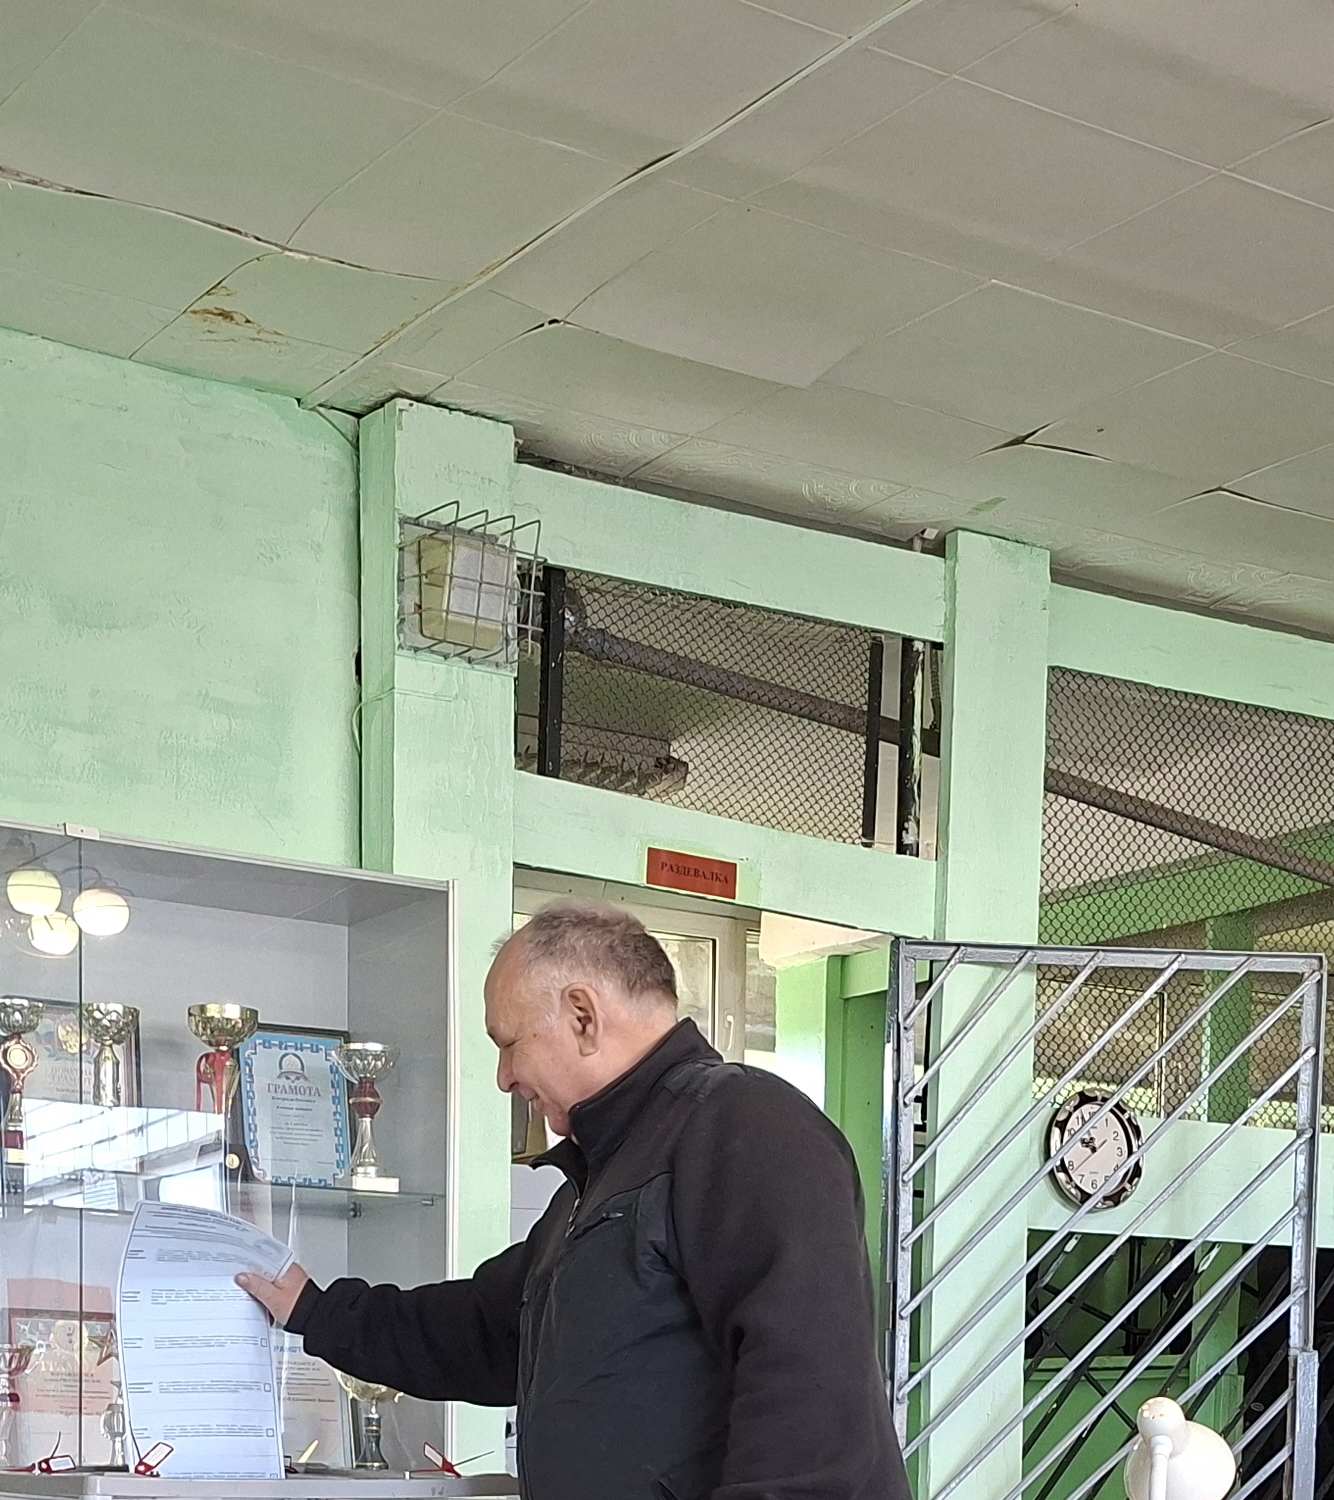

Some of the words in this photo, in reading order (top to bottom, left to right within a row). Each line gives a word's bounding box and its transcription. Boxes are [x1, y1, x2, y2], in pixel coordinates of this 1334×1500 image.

[660, 861, 729, 884] РАЗДЕВАЛКА
[267, 1083, 323, 1097] ГРАМОТА
[1112, 1131, 1119, 1141] 2
[1116, 1147, 1123, 1157] 3
[1068, 1161, 1075, 1171] 8
[1078, 1174, 1085, 1184] 7
[1091, 1179, 1098, 1189] 6
